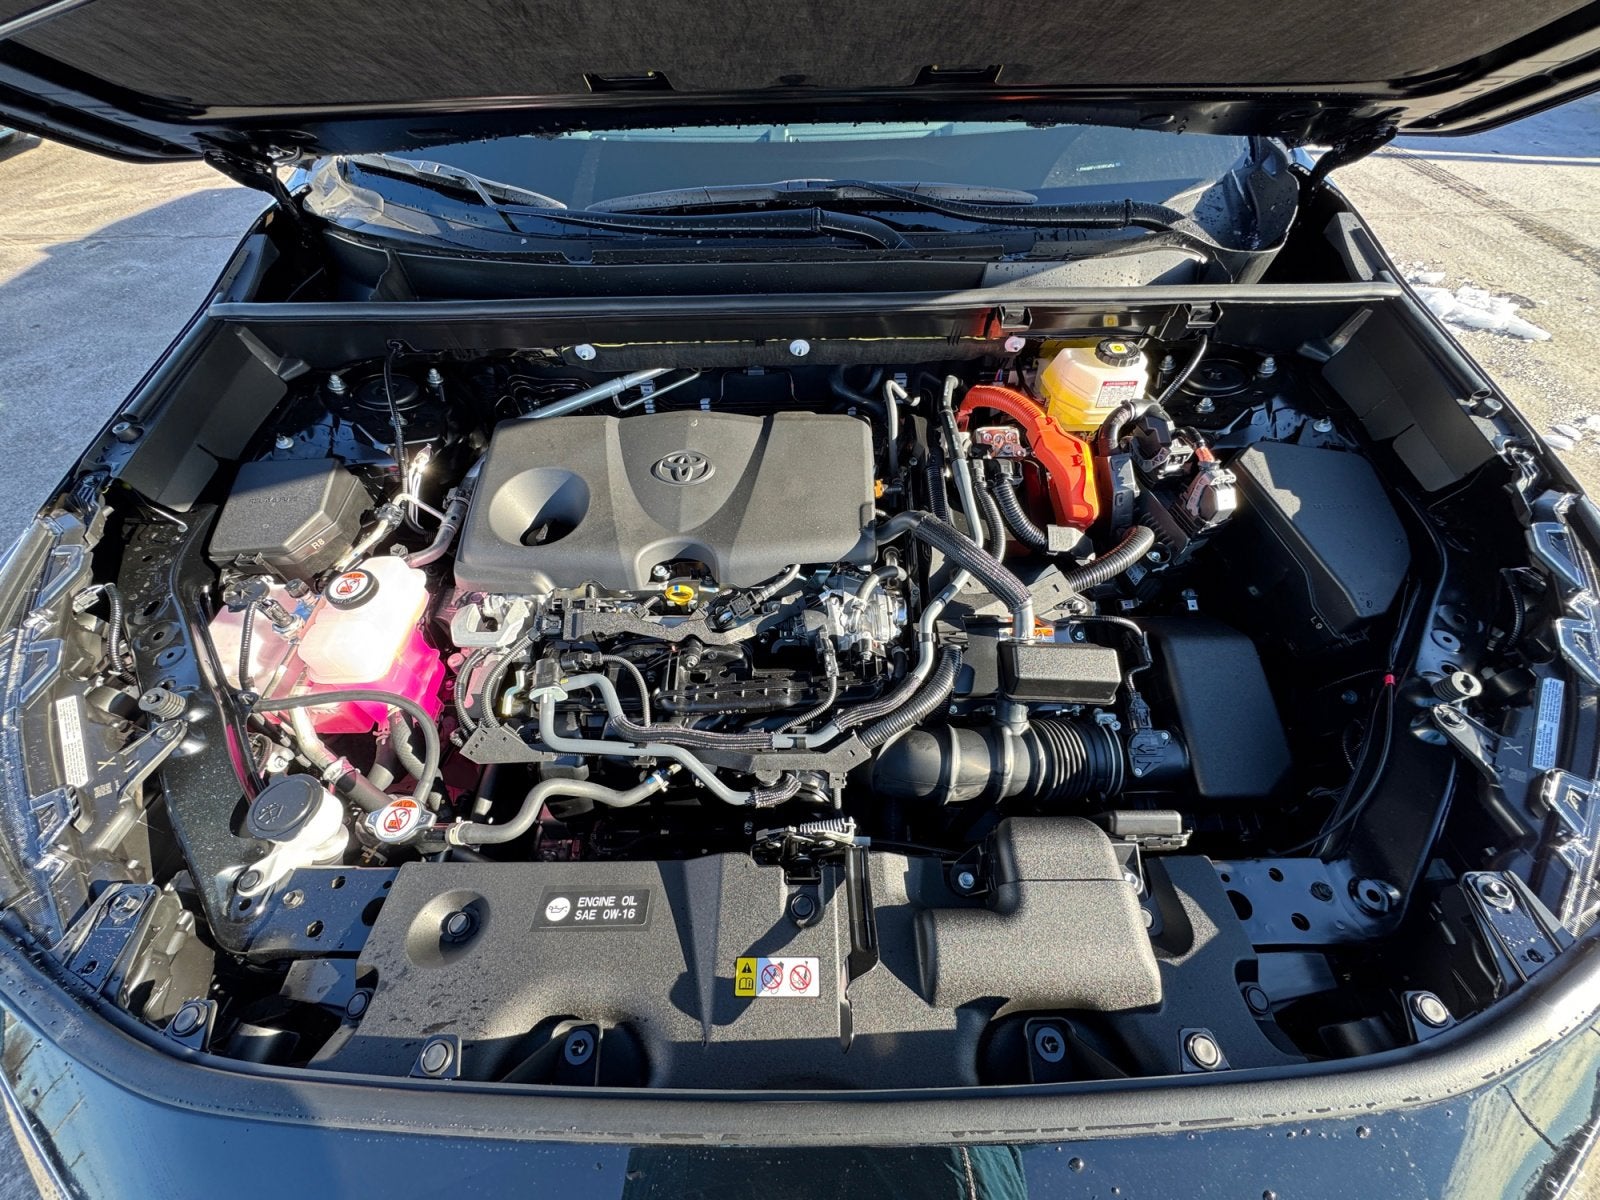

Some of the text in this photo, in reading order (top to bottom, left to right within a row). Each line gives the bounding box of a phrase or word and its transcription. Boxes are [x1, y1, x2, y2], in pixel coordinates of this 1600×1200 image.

[311, 538, 325, 550] R8
[577, 895, 638, 907] ENGINE OIL
[574, 908, 636, 921] SAE 0W-16
